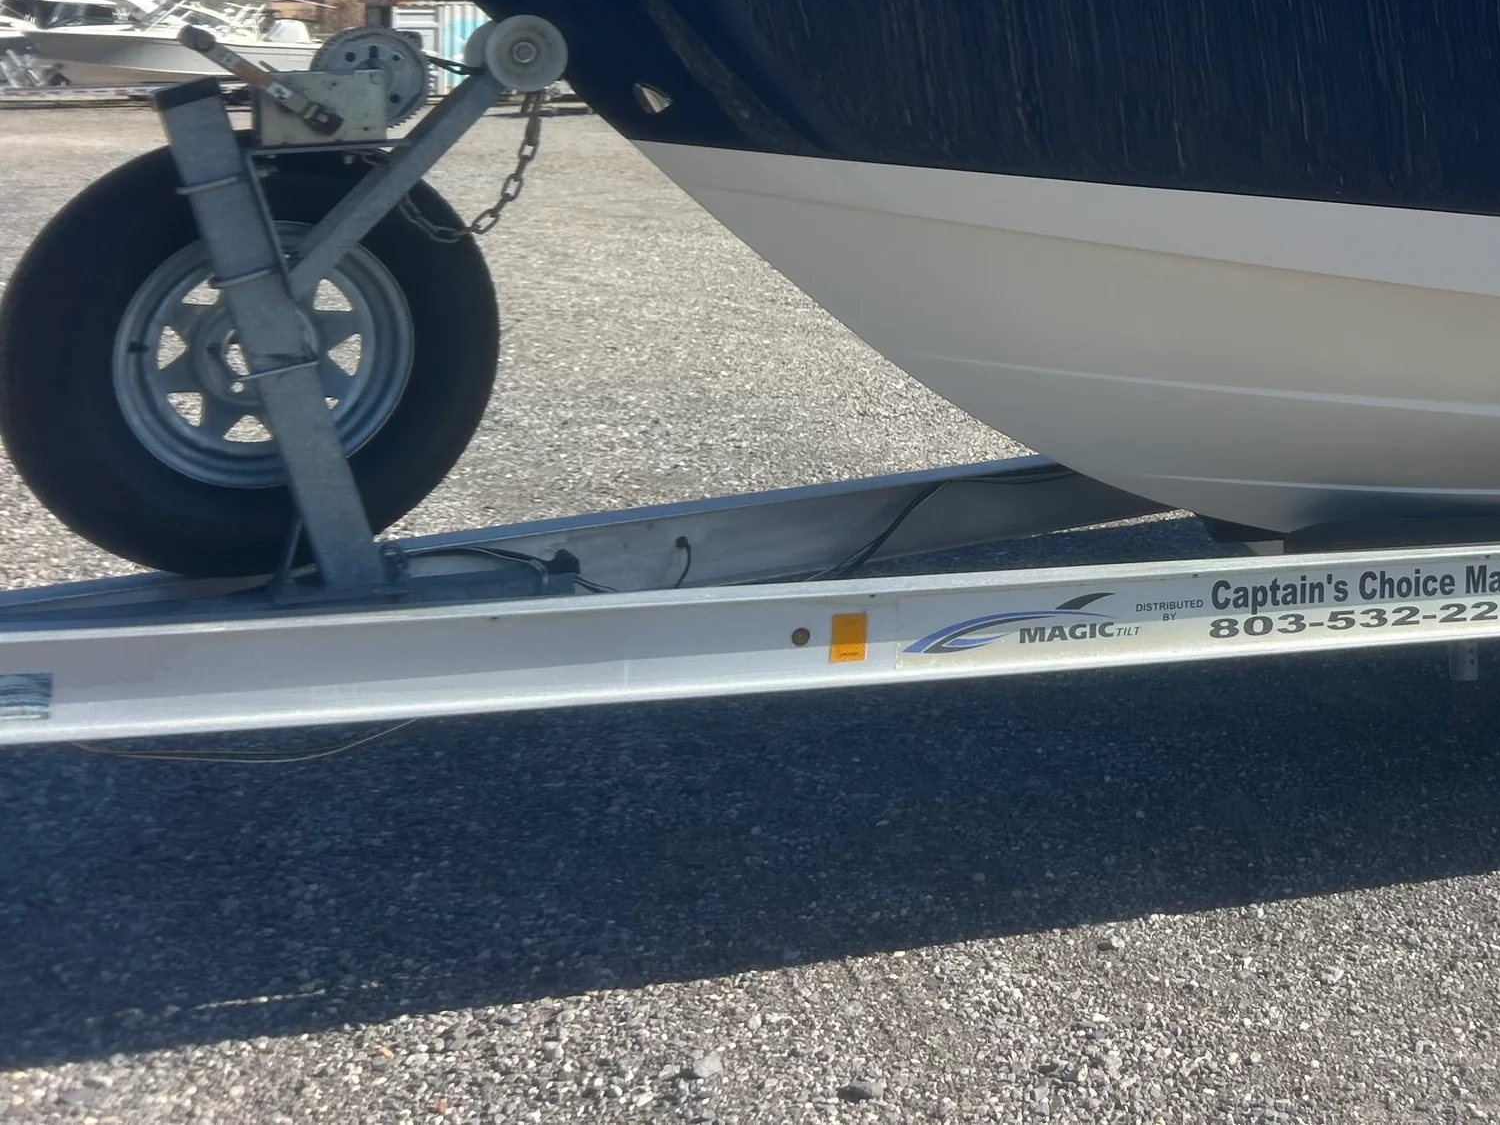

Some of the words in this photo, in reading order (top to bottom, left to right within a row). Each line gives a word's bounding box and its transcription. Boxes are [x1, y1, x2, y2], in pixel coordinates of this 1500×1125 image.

[1211, 573, 1349, 614] Captain's
[1358, 569, 1456, 601] Choice
[1135, 599, 1204, 612] DISTRIBUTED
[1162, 612, 1177, 622] BY
[1019, 621, 1115, 644] MAGIC
[1115, 626, 1142, 637] TILT
